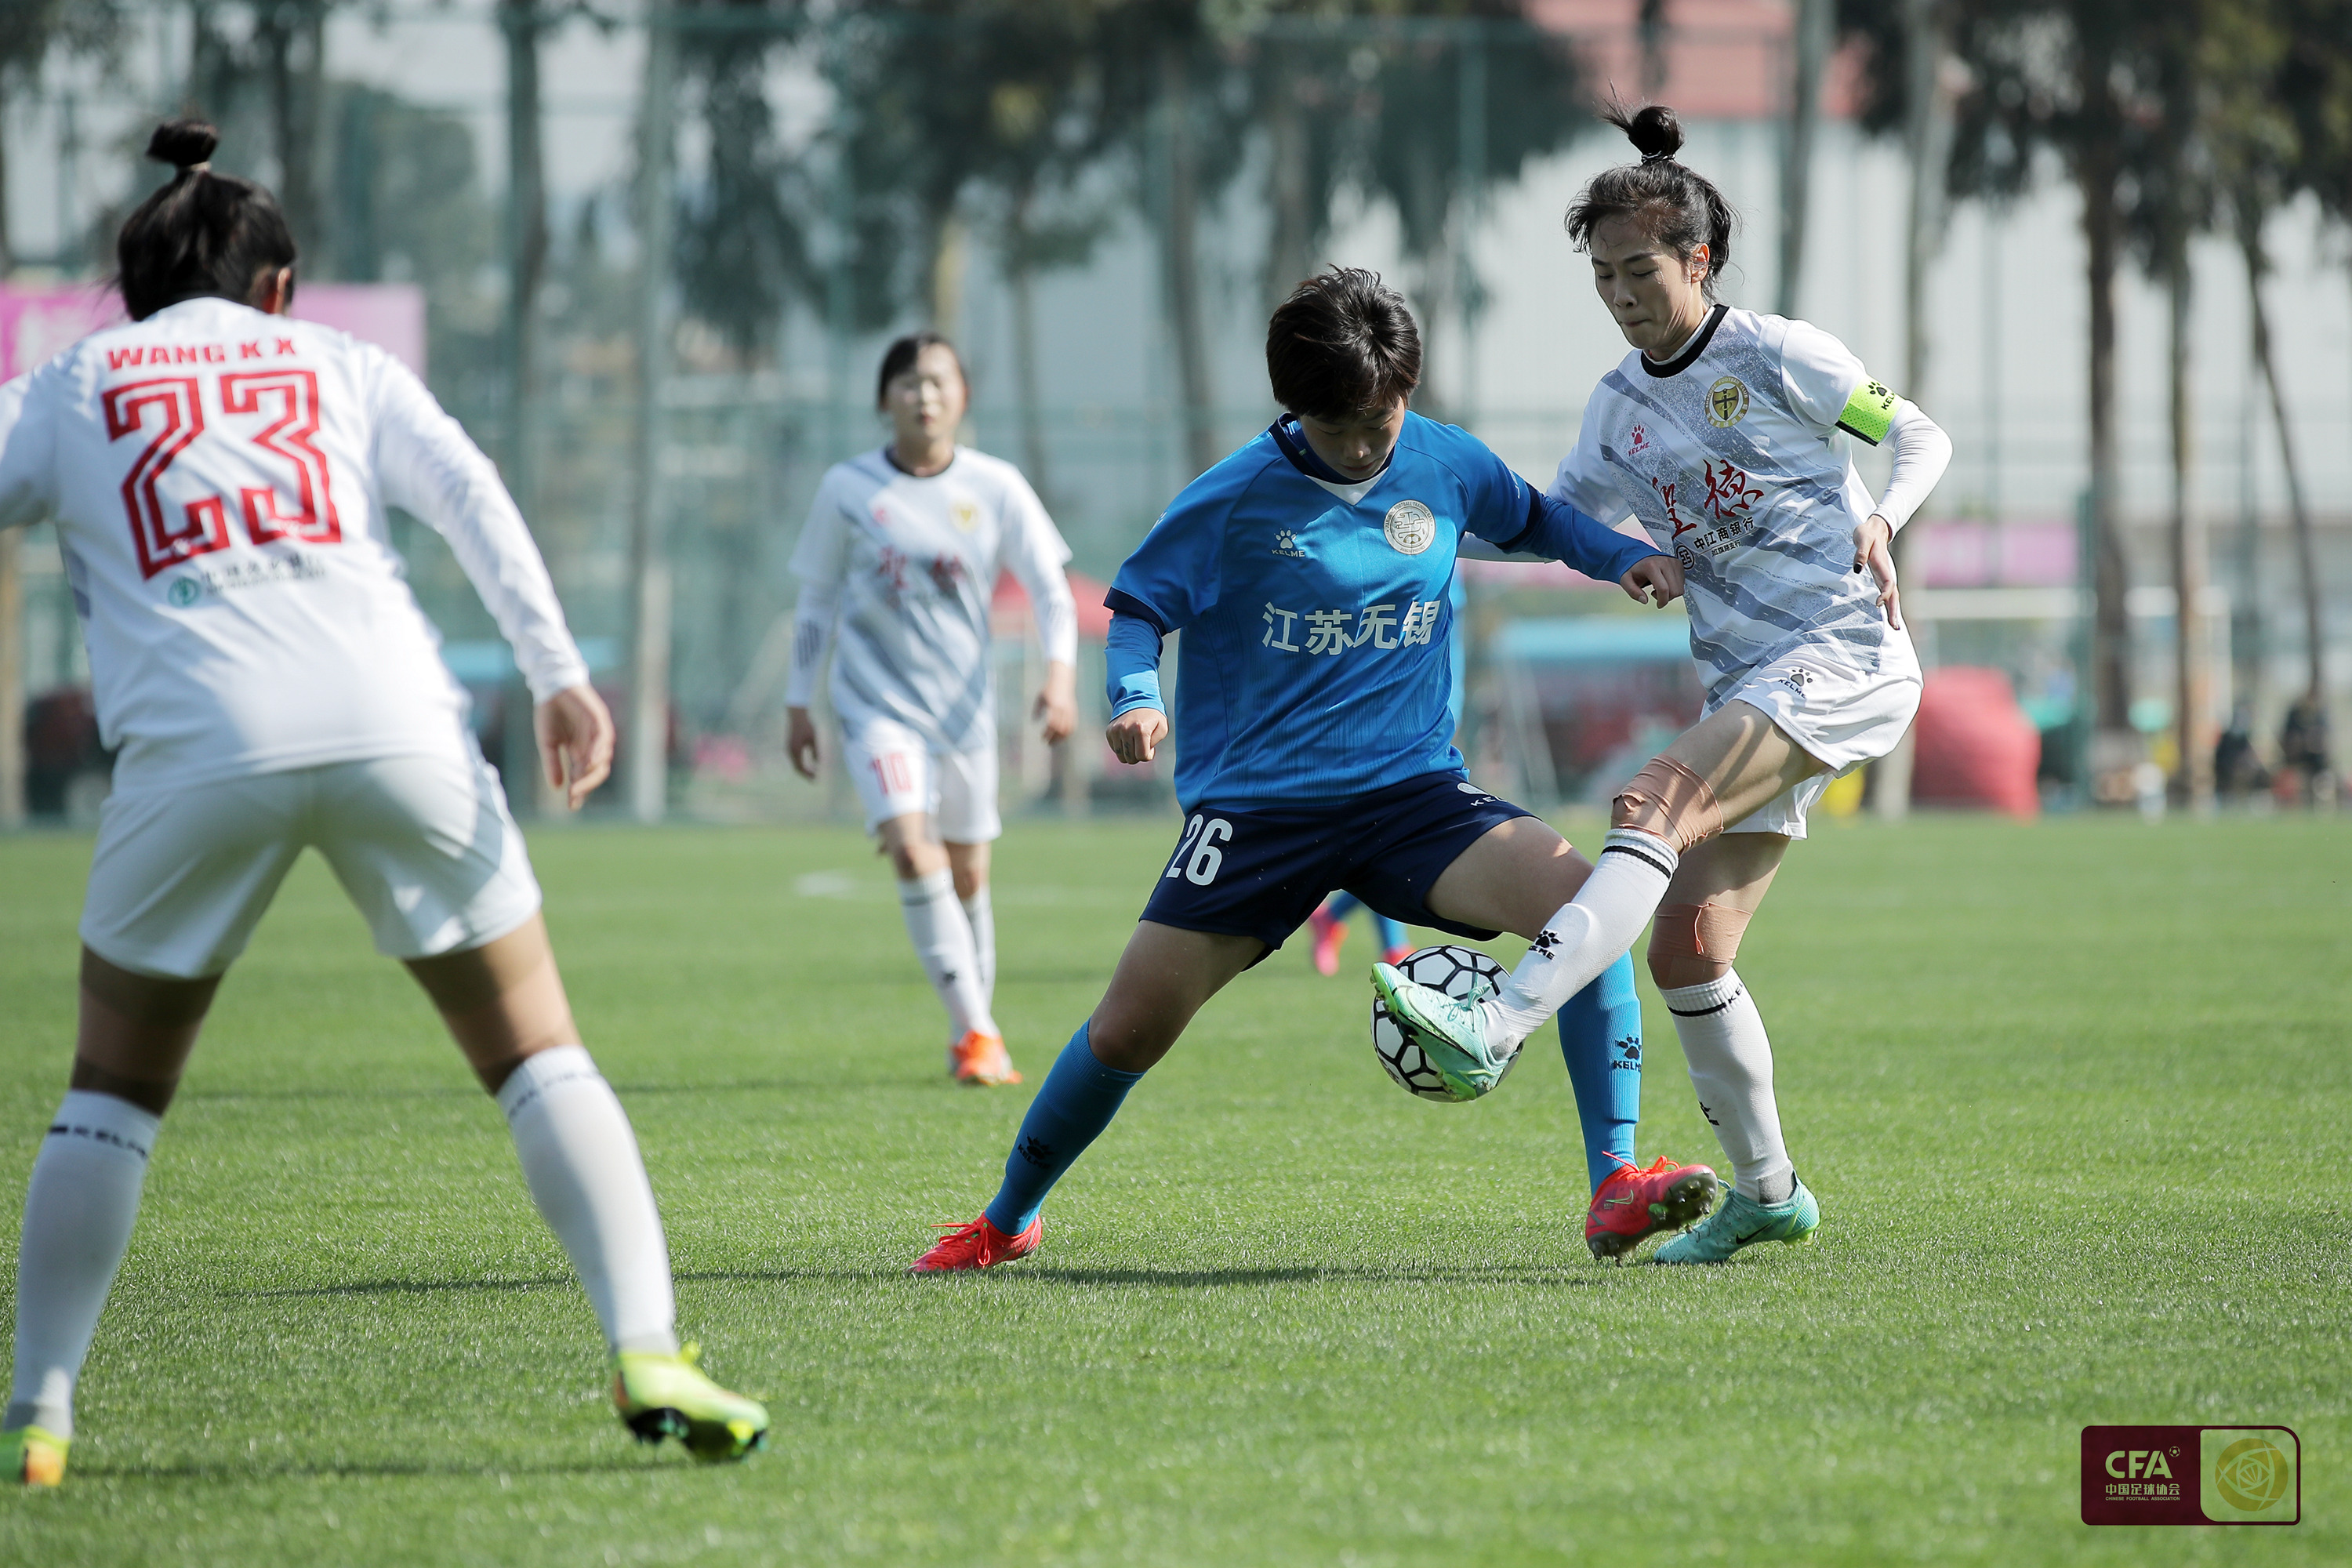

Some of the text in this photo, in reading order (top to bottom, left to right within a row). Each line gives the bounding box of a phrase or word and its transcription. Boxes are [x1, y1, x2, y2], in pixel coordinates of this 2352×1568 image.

[107, 337, 297, 370] WANG K X
[1628, 441, 1650, 457] KELME
[101, 370, 341, 580] 23
[1271, 549, 1305, 557] KELME
[1261, 600, 1441, 655] 江苏无锡
[1777, 678, 1806, 699] KELME
[1166, 813, 1233, 886] 26
